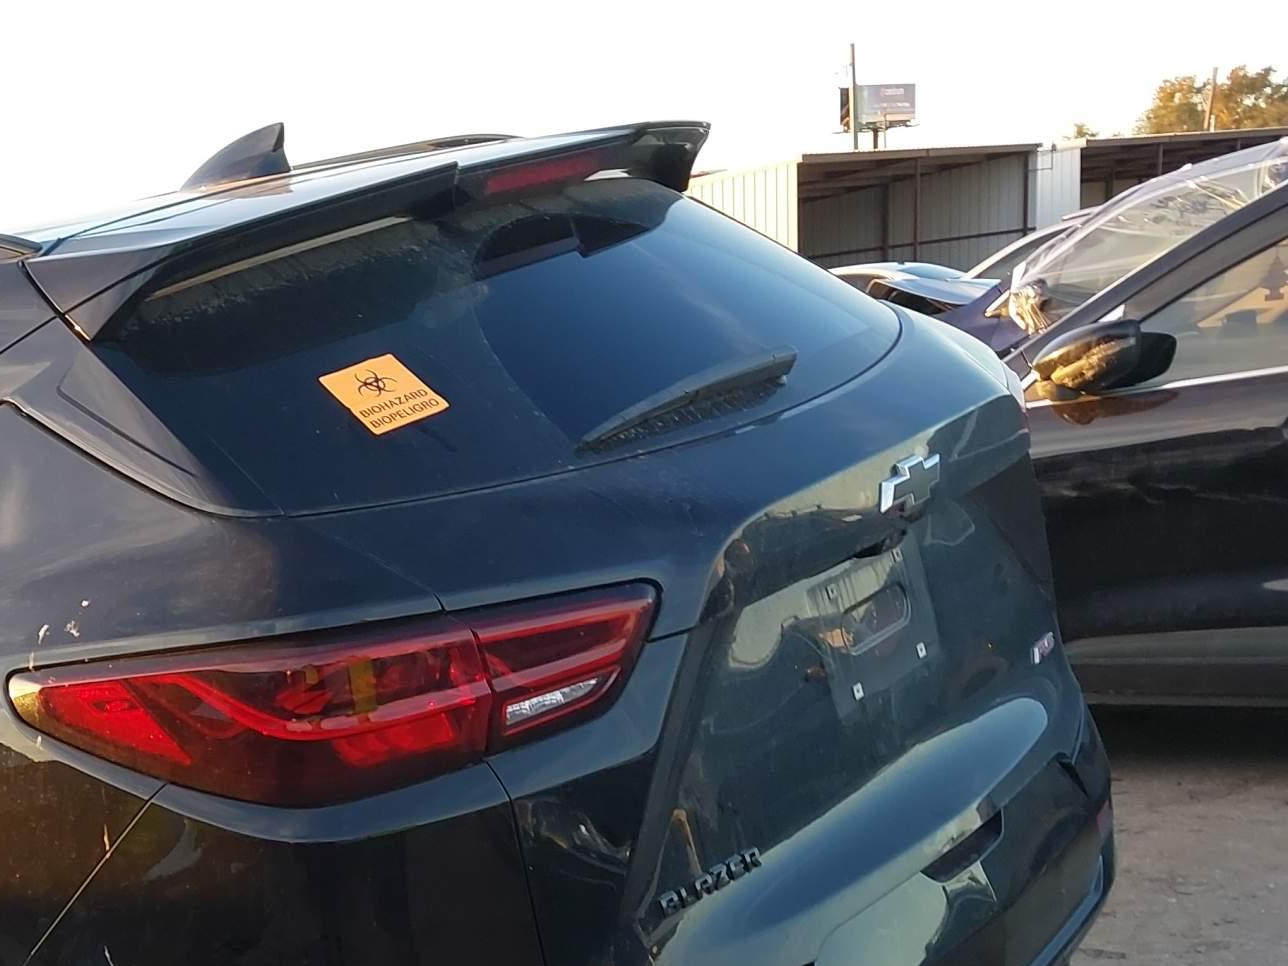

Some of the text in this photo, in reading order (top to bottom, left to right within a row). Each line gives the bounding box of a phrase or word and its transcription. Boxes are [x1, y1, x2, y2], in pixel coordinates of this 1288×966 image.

[359, 388, 429, 418] BIOHAZARD
[369, 398, 440, 429] BIOPELIGRO
[659, 847, 763, 917] BLAZER
